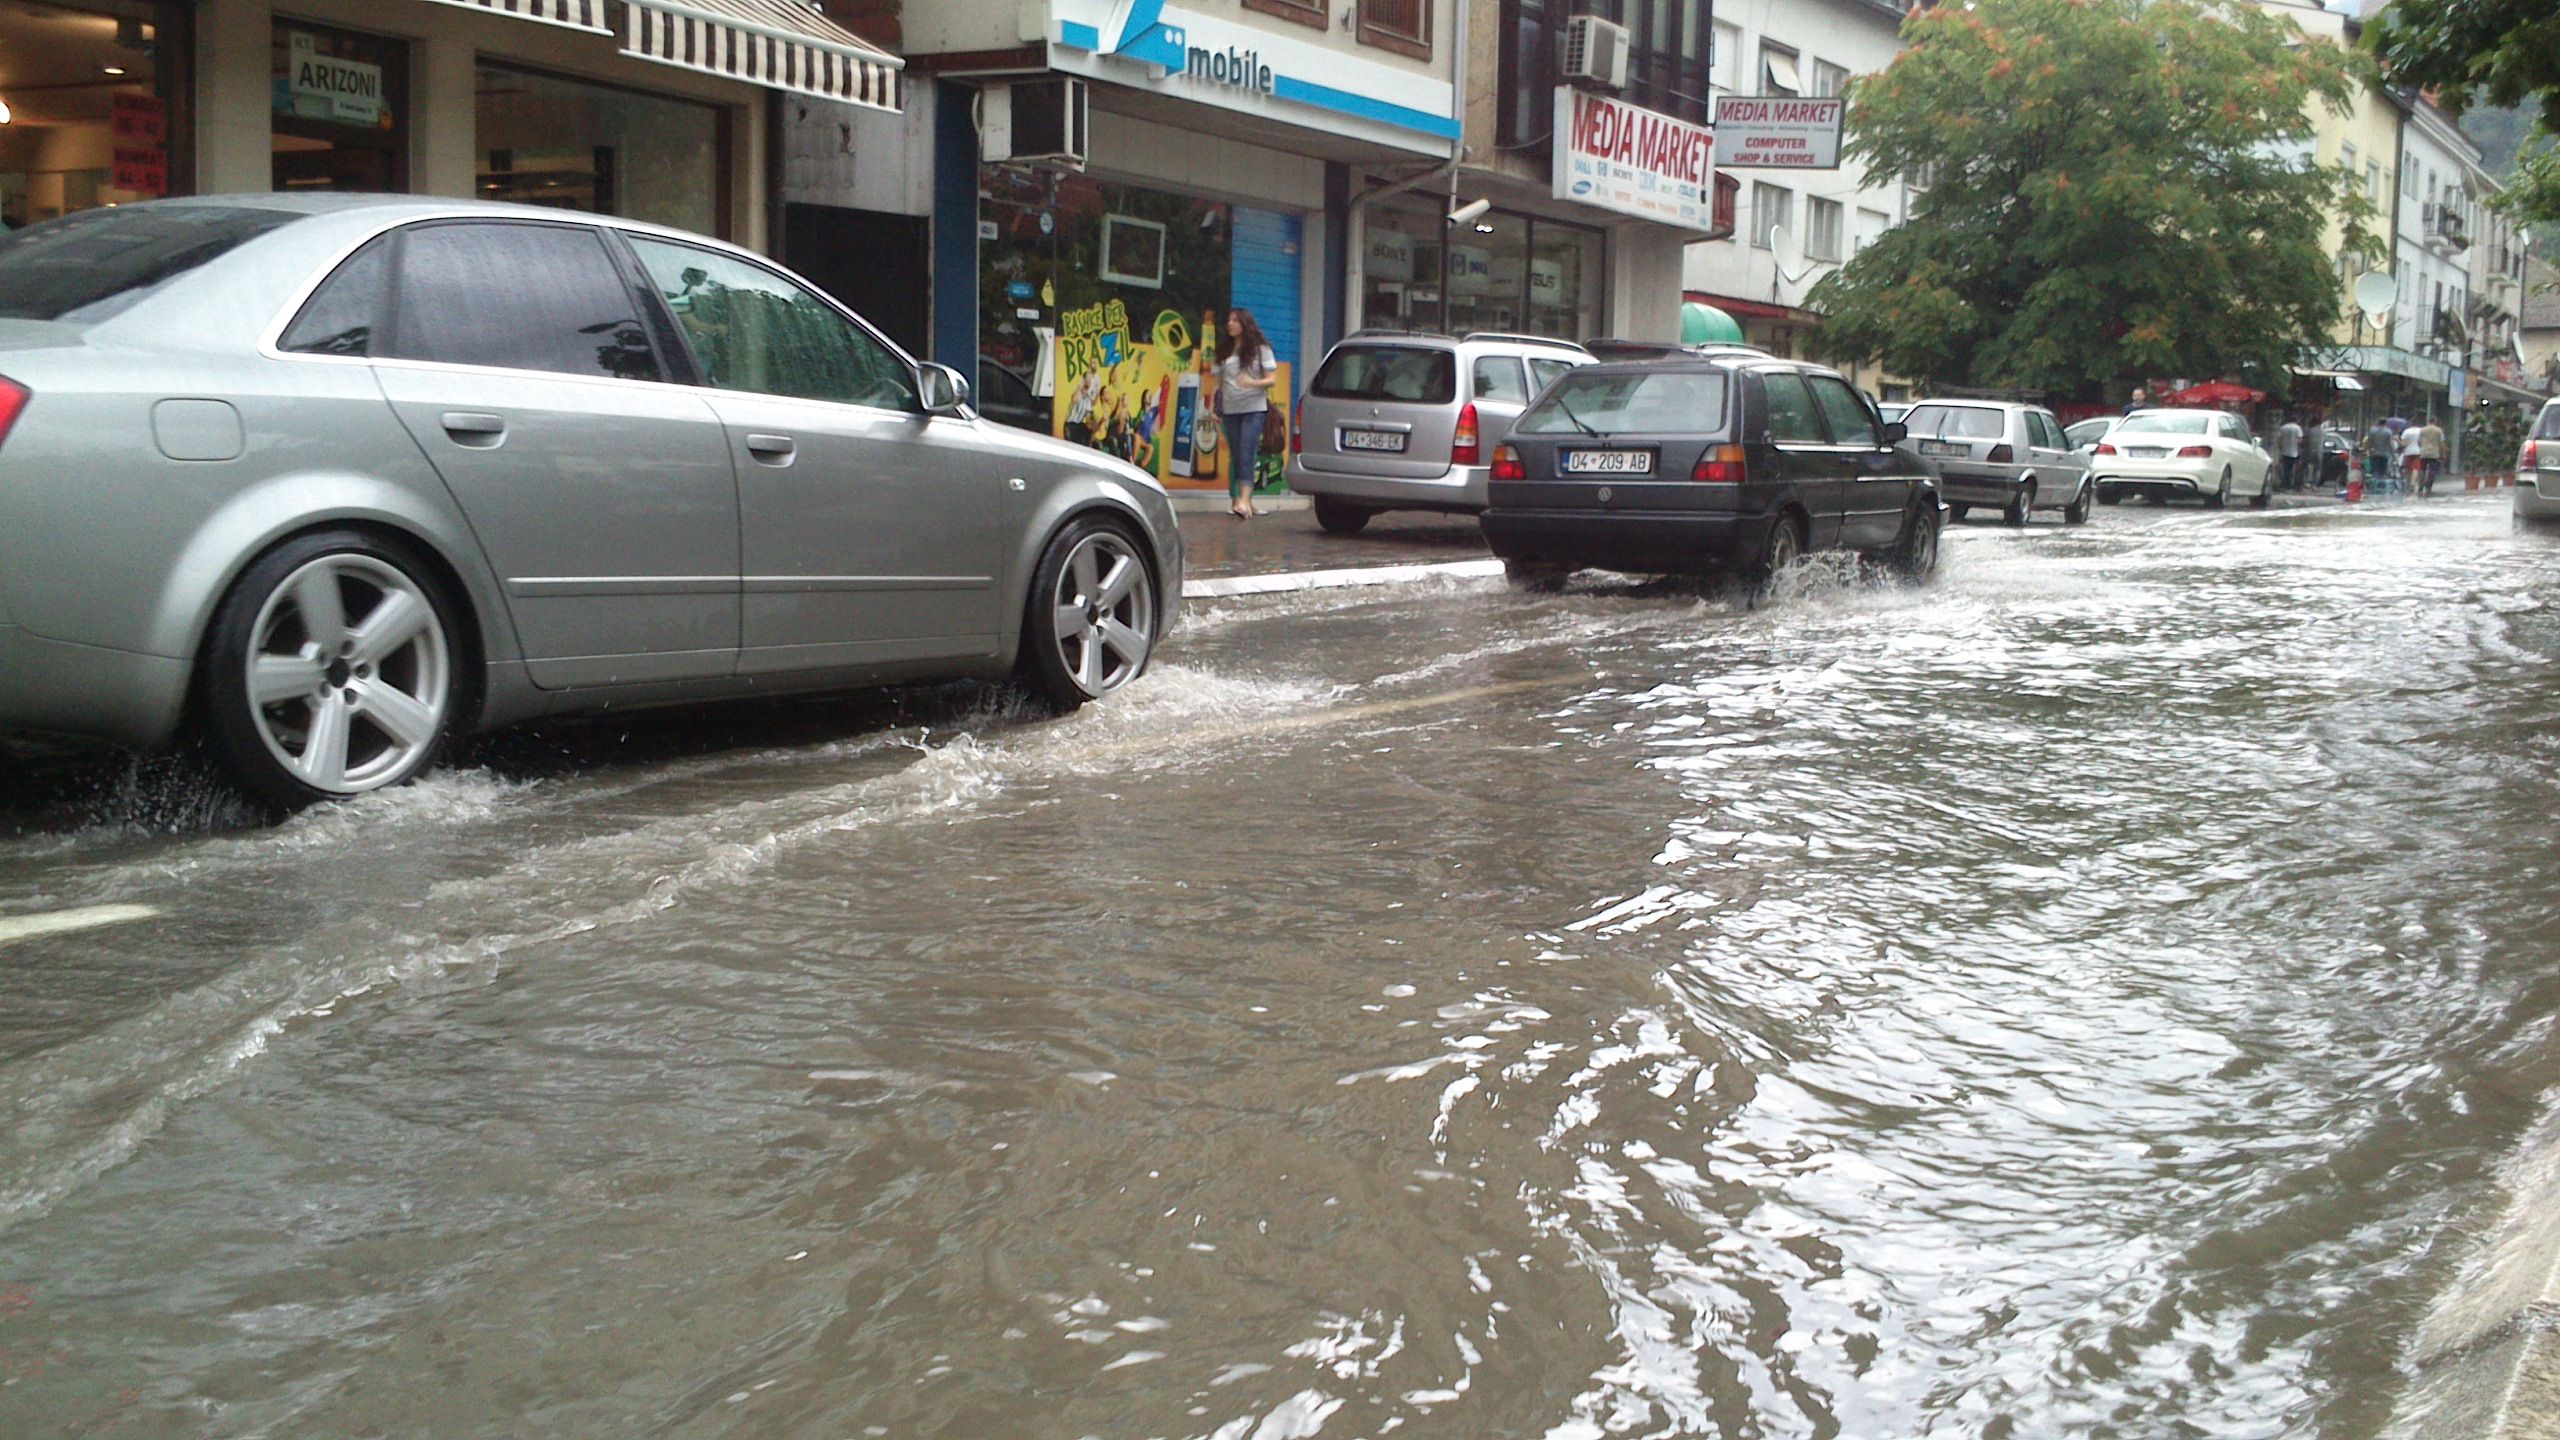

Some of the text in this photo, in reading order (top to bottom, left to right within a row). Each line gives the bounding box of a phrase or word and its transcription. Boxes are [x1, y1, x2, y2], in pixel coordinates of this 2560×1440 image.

[1188, 44, 1272, 92] mobile
[299, 62, 376, 99] ARIZONI
[1720, 102, 1838, 123] MEDIA MARKET
[1571, 93, 1714, 186] MEDIA MARKET
[1745, 137, 1807, 149] COMPUTER
[1733, 152, 1816, 164] SHOP & SERVICE
[1373, 243, 1406, 262] SONY
[1062, 326, 1136, 383] BRAZIL
[1347, 432, 1359, 447] 04
[1366, 434, 1384, 448] 346
[1571, 453, 1647, 470] 04 209 AB
